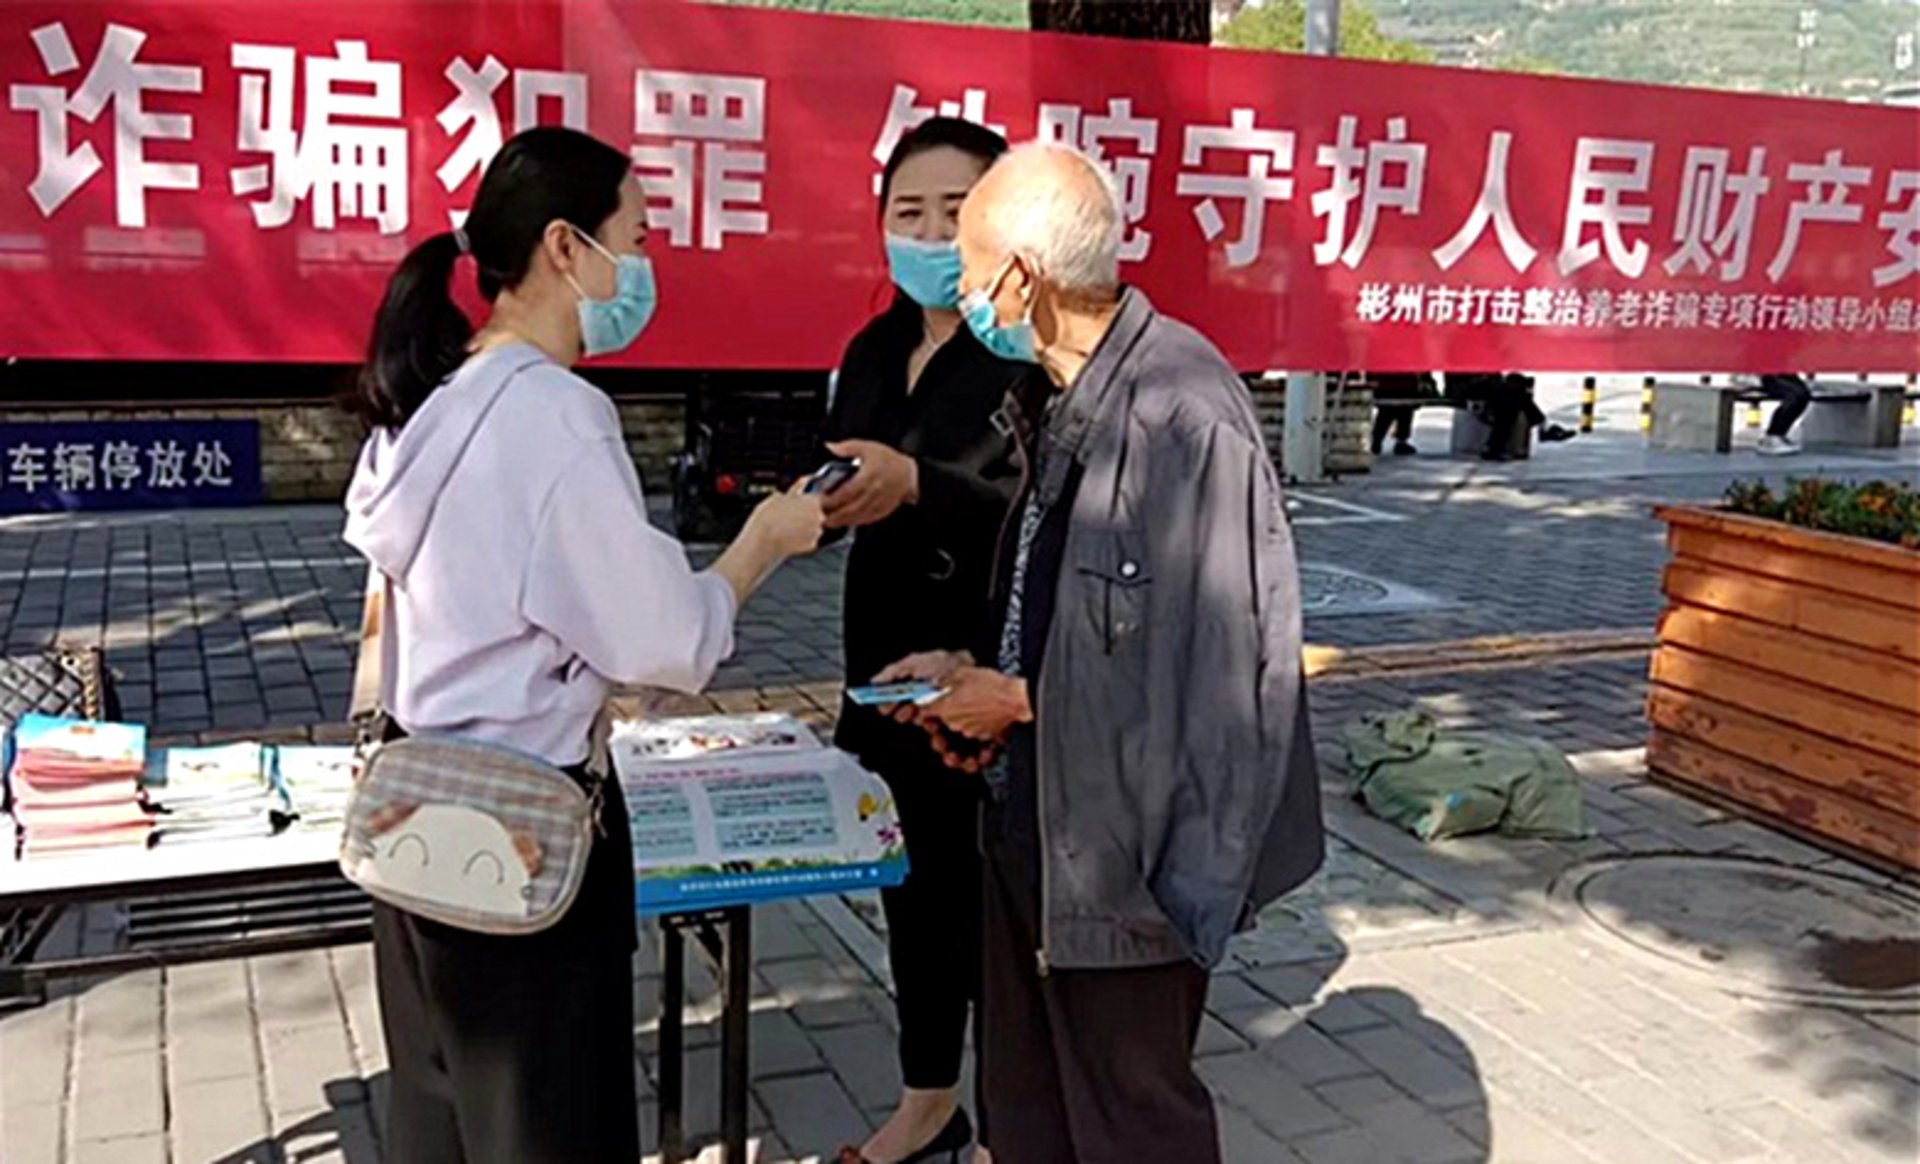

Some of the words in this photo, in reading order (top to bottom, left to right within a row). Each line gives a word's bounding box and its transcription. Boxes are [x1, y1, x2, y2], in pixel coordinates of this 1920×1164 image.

[1356, 283, 1920, 333] 彬州市打击整治养老诈骗专项行动领导小组
[0, 441, 232, 492] 车辆停放处
